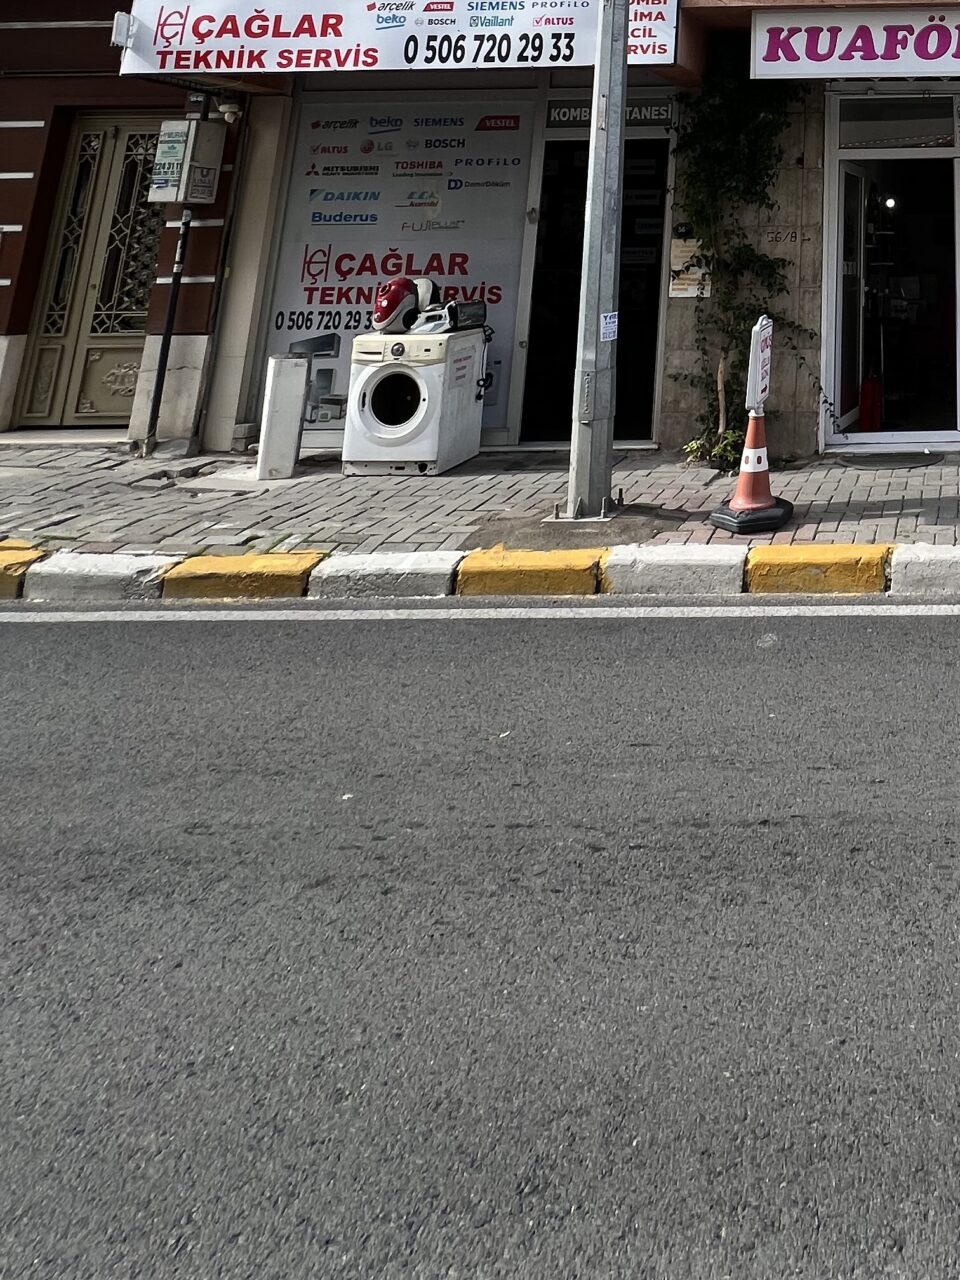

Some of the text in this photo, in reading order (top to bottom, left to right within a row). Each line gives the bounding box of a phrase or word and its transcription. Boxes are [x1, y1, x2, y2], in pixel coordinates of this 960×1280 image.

[377, 0, 416, 12] arçelik
[430, 3, 452, 11] VESTEL
[467, 0, 525, 11] SIEMENS
[376, 13, 407, 25] beko
[428, 18, 456, 26] BOSCH
[479, 15, 515, 27] Vaillant
[544, 17, 575, 26] ALTUS
[192, 8, 344, 45] ÇAĞLAR
[629, 25, 657, 38] CİL
[403, 32, 575, 64] 0 506 720 29 33
[626, 42, 668, 55] RVİS
[155, 43, 379, 70] TEKNİK SERVİS
[550, 107, 591, 121] KOMB
[369, 116, 403, 128] beko
[413, 117, 465, 128] SIEMENS
[485, 119, 517, 128] VESTEL
[320, 145, 349, 154] ALTUS
[377, 141, 393, 151] LG
[424, 138, 466, 149] BOSCH
[394, 161, 443, 170] TOSHIBA
[323, 191, 381, 201] DAIKIN
[311, 211, 378, 223] Buderus
[334, 247, 470, 281] ÇAĞLAR
[275, 310, 376, 330] 0 506 720 29 3
